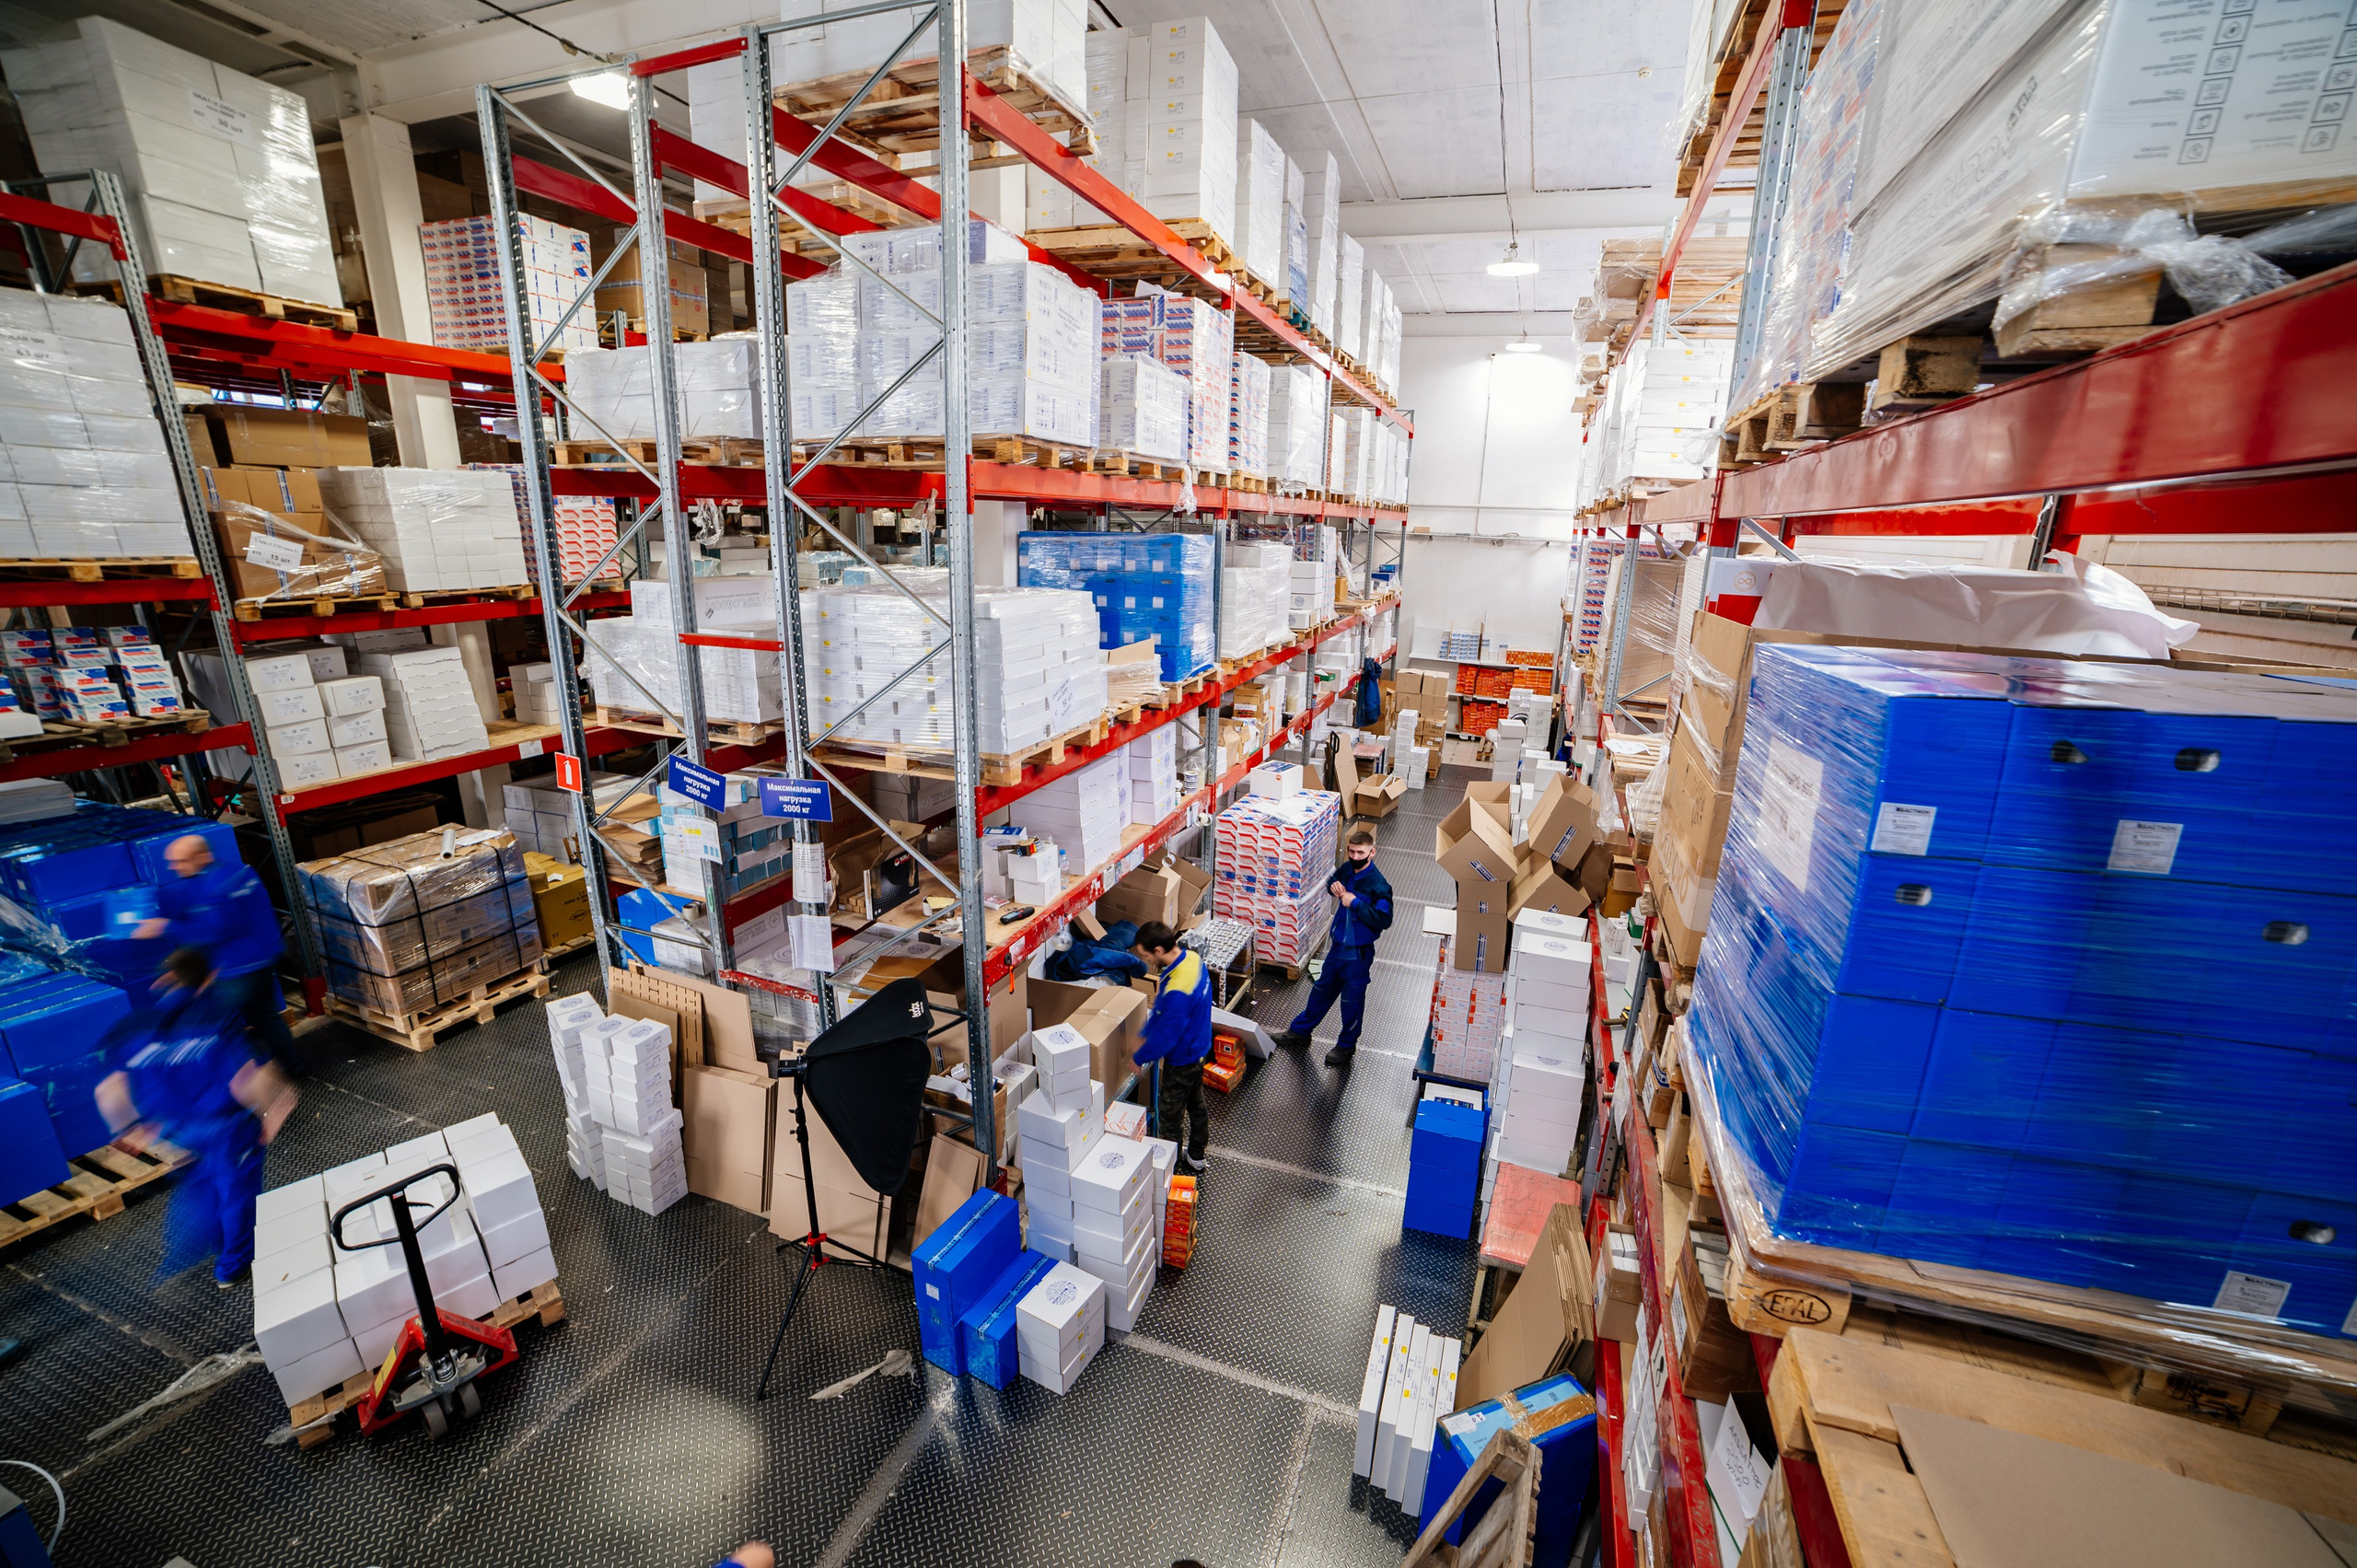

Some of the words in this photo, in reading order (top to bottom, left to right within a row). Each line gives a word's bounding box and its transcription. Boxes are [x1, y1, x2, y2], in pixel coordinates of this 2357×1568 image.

[675, 761, 720, 787] Максимальная
[683, 775, 711, 793] нагрузка
[685, 784, 701, 797] 2000
[701, 791, 709, 800] кг
[767, 783, 821, 795] Максимальная
[779, 795, 812, 805] нагрузка
[783, 805, 801, 813] 2000
[1770, 1294, 1818, 1321] EPAL
